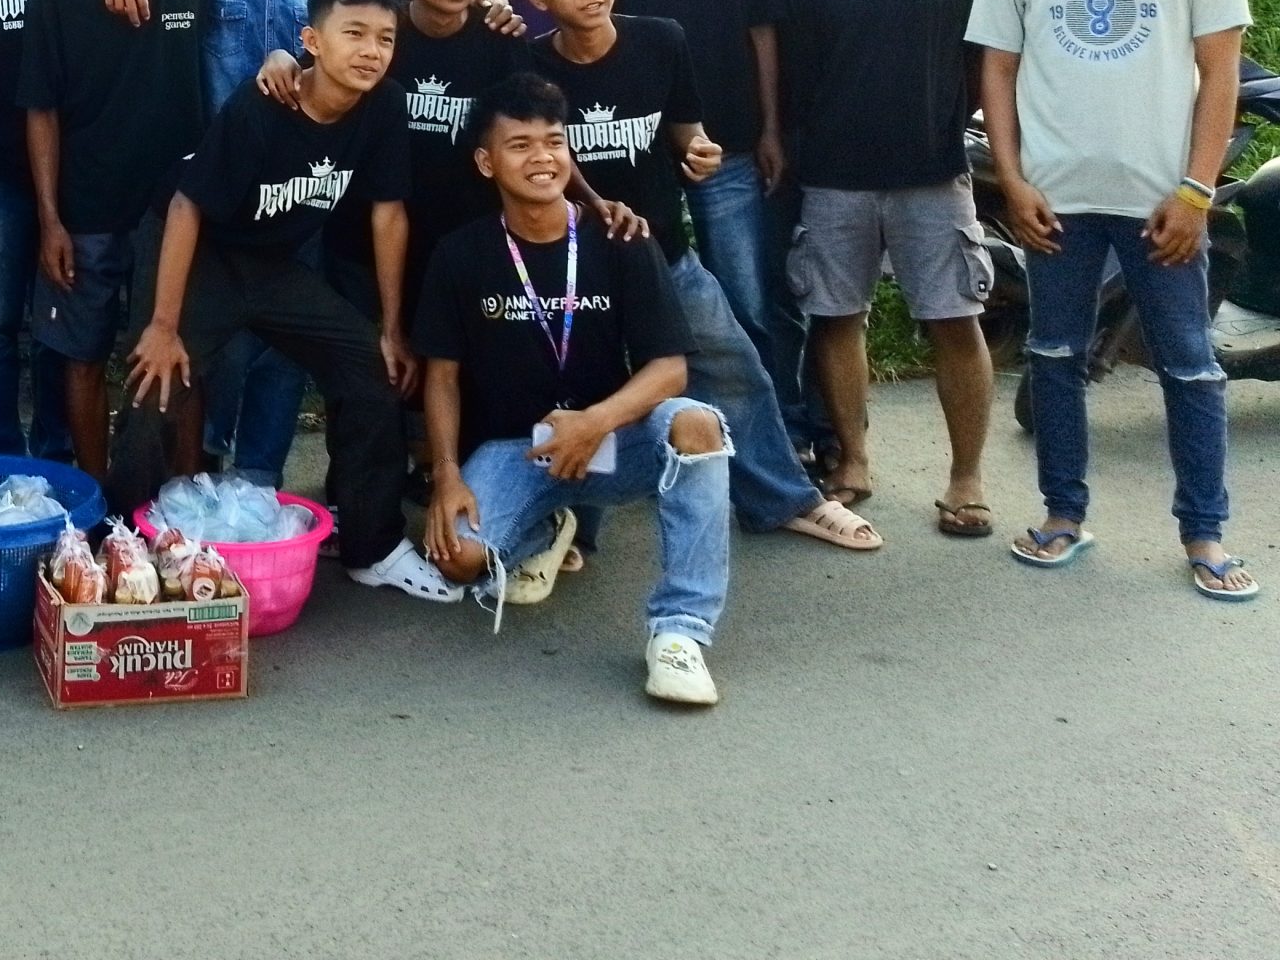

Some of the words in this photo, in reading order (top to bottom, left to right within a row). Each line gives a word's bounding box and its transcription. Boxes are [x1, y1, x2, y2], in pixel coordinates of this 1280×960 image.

[161, 10, 195, 22] pemuda
[1049, 4, 1064, 20] 19
[1139, 2, 1157, 18] 96
[1053, 25, 1088, 60] BELIEVE
[1089, 50, 1101, 62] IN
[1101, 23, 1152, 62] YOURSELF
[482, 297, 498, 312] 19
[116, 637, 179, 655] HARUM
